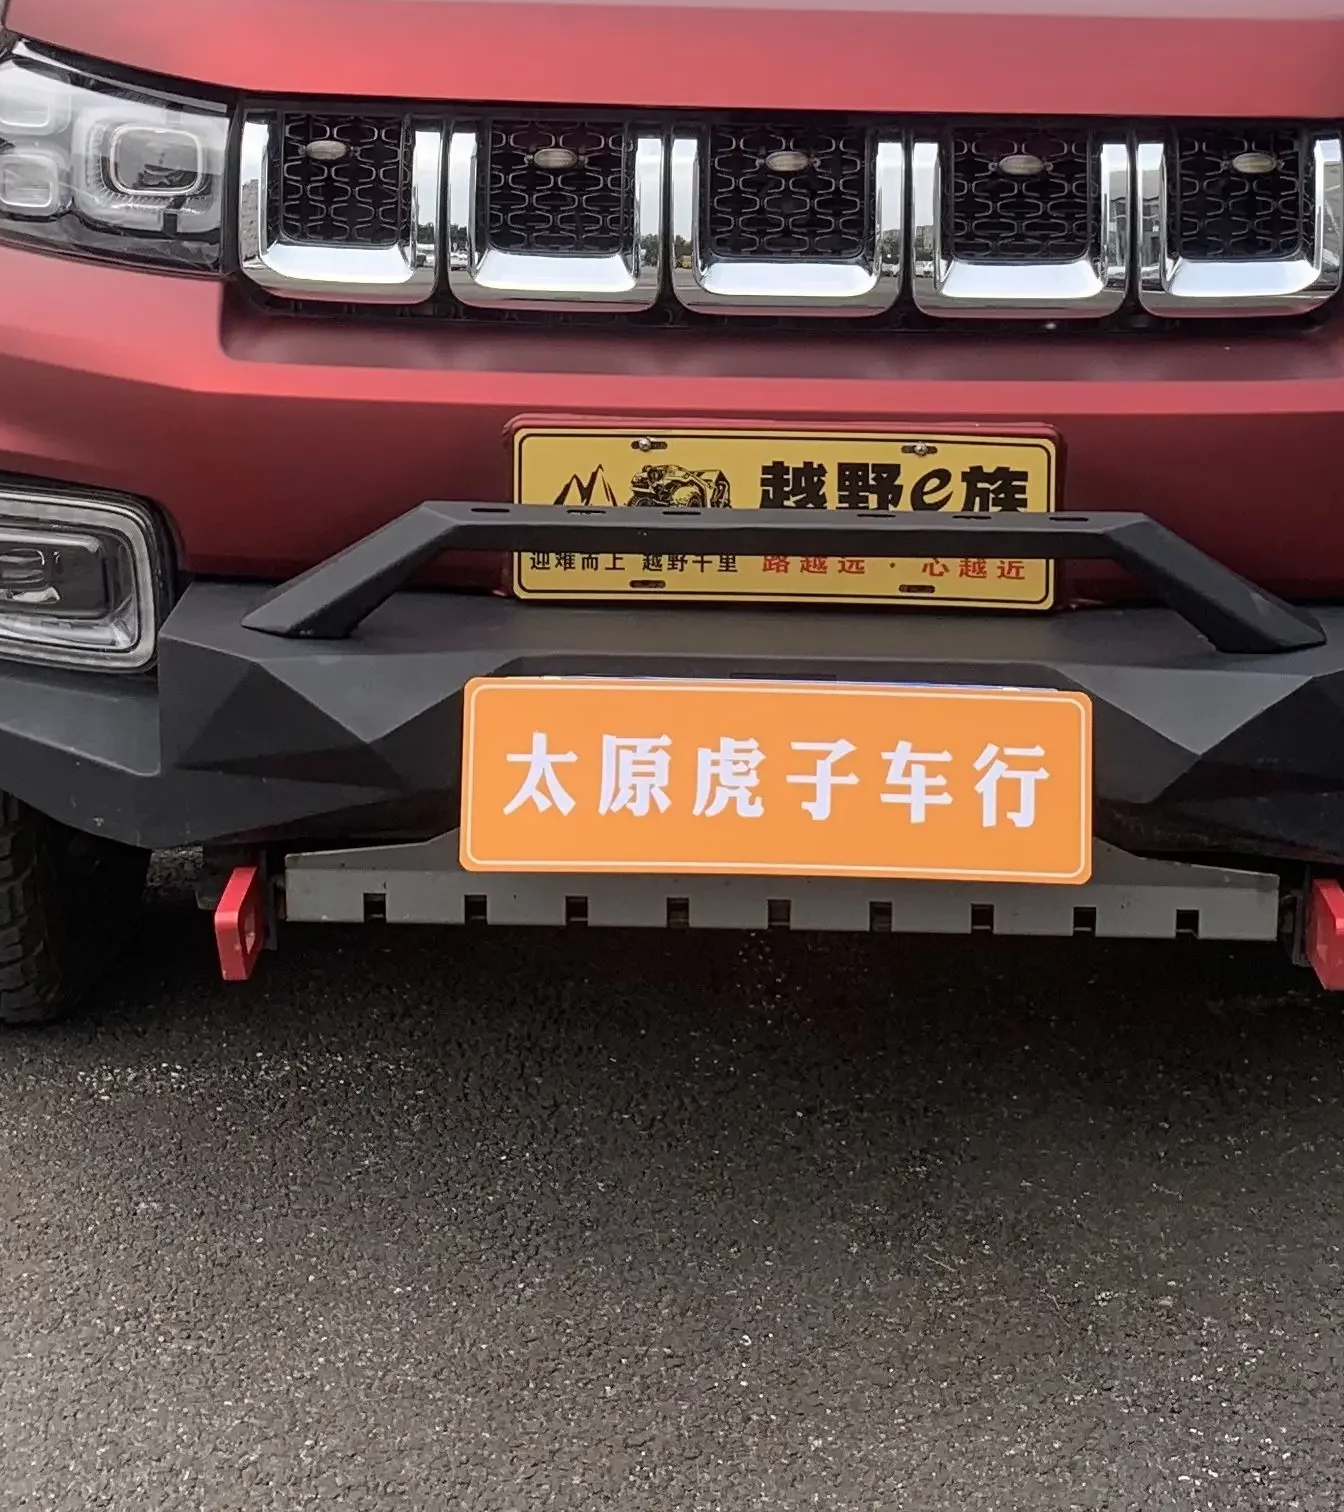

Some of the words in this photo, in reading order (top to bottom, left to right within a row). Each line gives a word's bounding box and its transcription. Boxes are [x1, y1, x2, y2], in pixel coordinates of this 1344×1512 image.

[759, 460, 1029, 513] 越野e族
[502, 731, 1051, 829] 太原虎子车行
